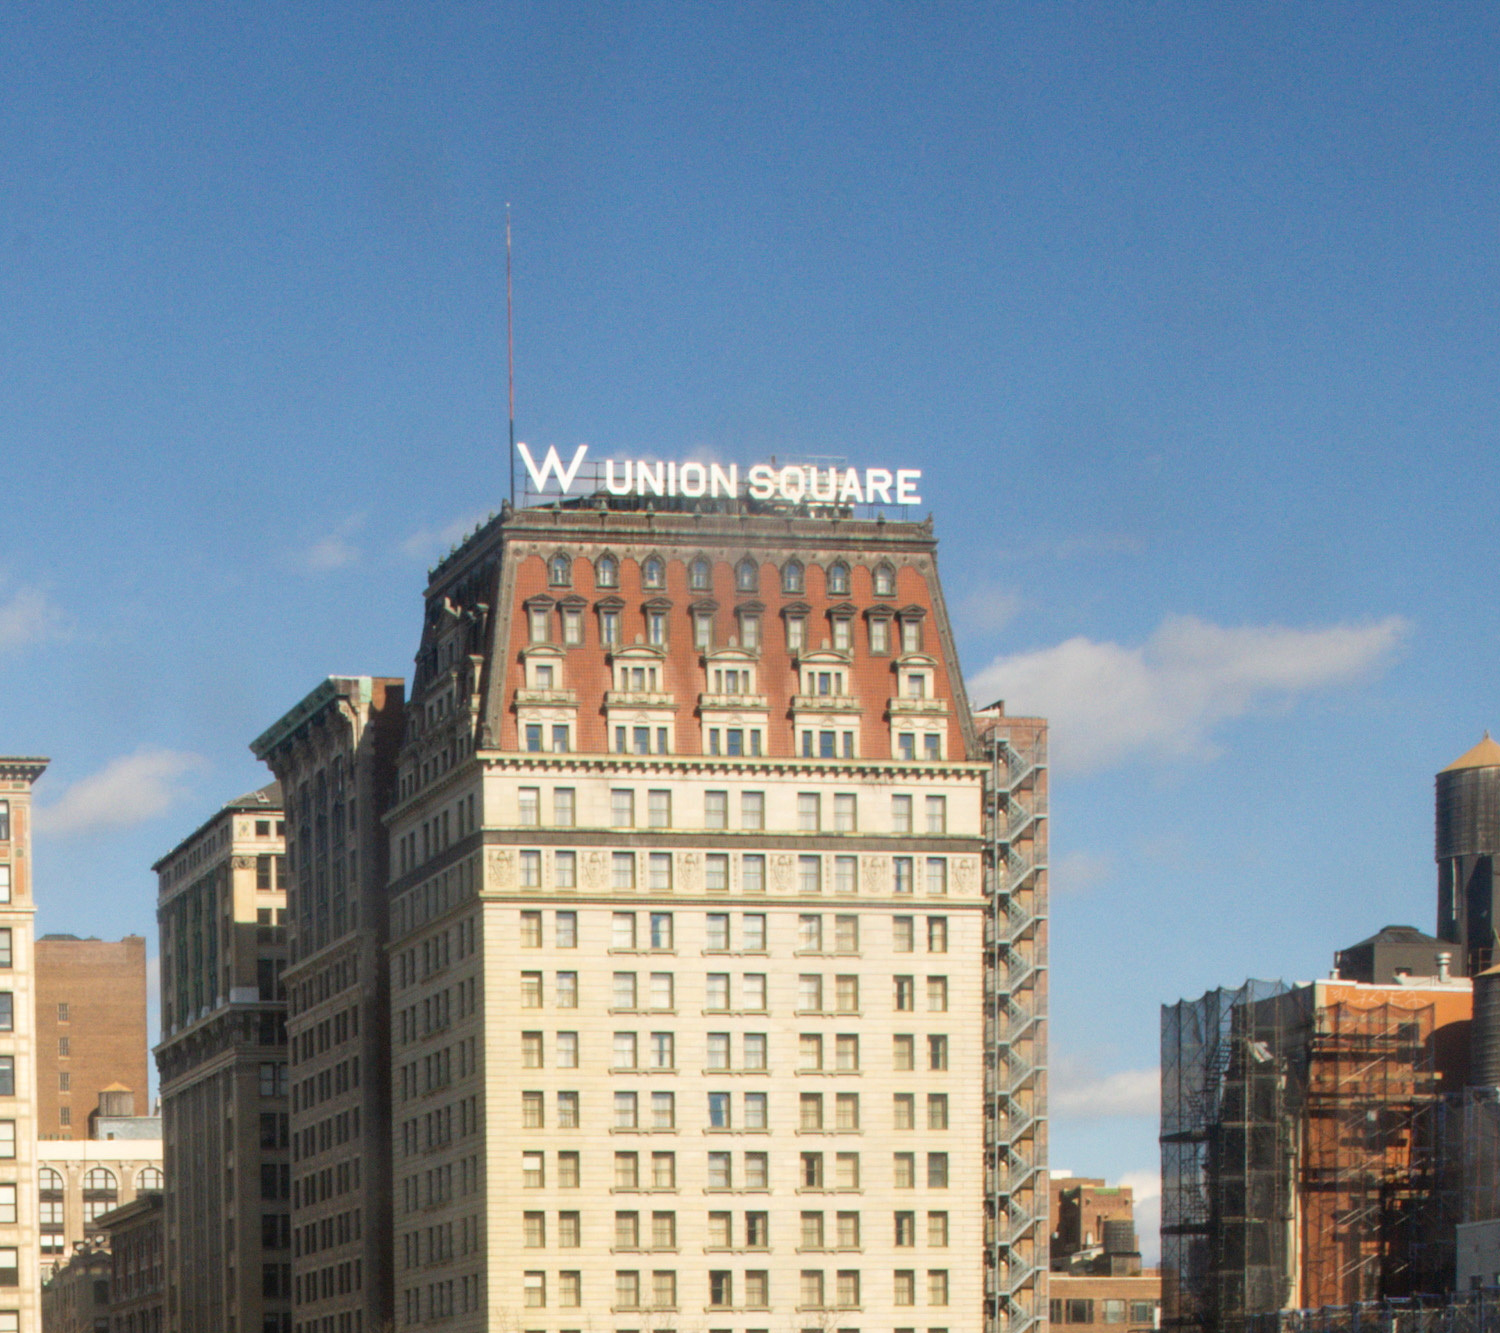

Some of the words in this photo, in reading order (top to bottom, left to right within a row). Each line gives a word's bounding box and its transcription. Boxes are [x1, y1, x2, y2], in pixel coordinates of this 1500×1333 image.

[517, 442, 588, 495] W
[604, 459, 738, 499] UNION
[748, 463, 922, 505] SQUARE
